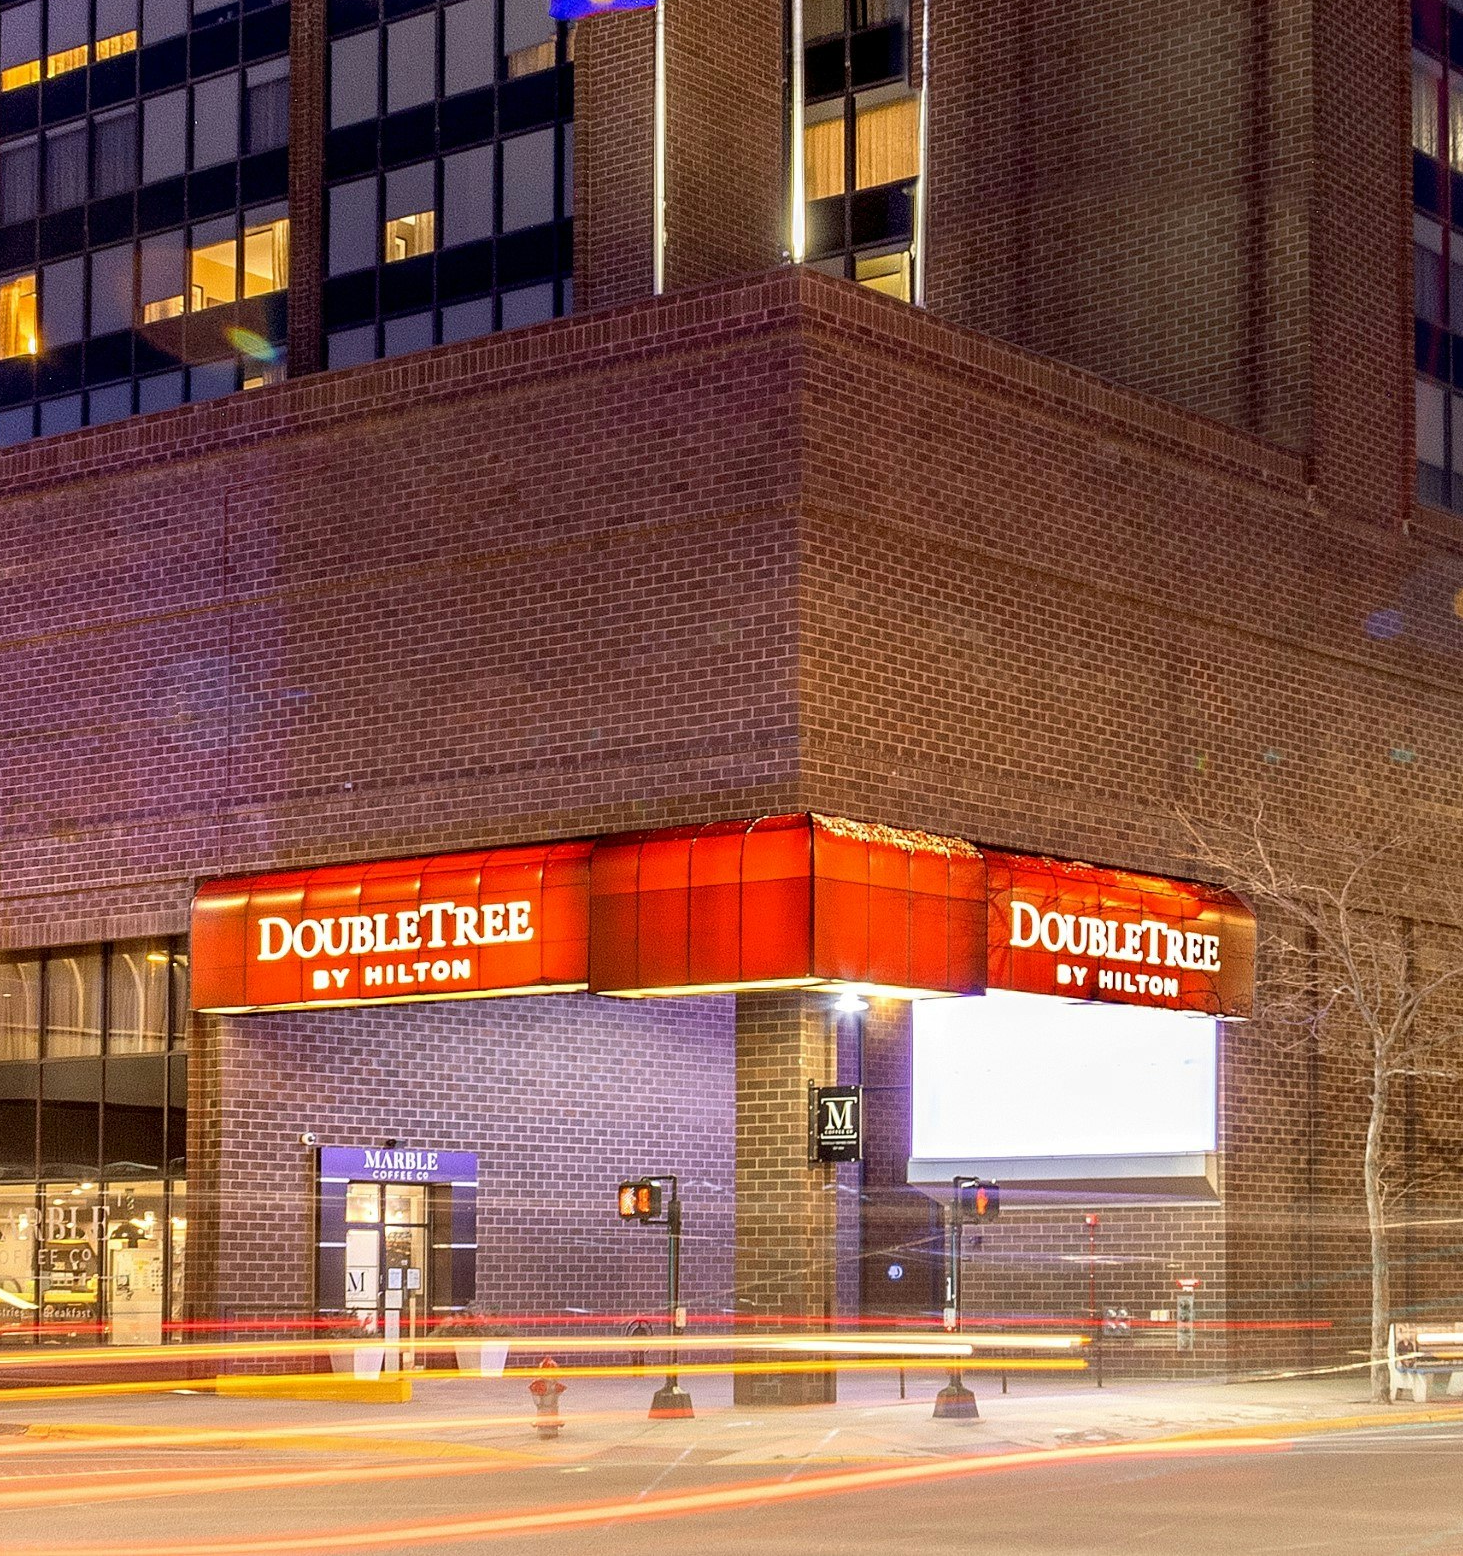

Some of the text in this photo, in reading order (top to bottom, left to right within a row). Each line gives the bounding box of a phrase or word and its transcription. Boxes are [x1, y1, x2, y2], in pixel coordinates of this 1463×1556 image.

[312, 958, 472, 990] BY HILTON
[1056, 963, 1179, 998] BY HILTON
[824, 1100, 854, 1130] M
[363, 1150, 439, 1171] MARBLE
[372, 1169, 413, 1181] COFFEE
[43, 1307, 92, 1319] Breakfast
